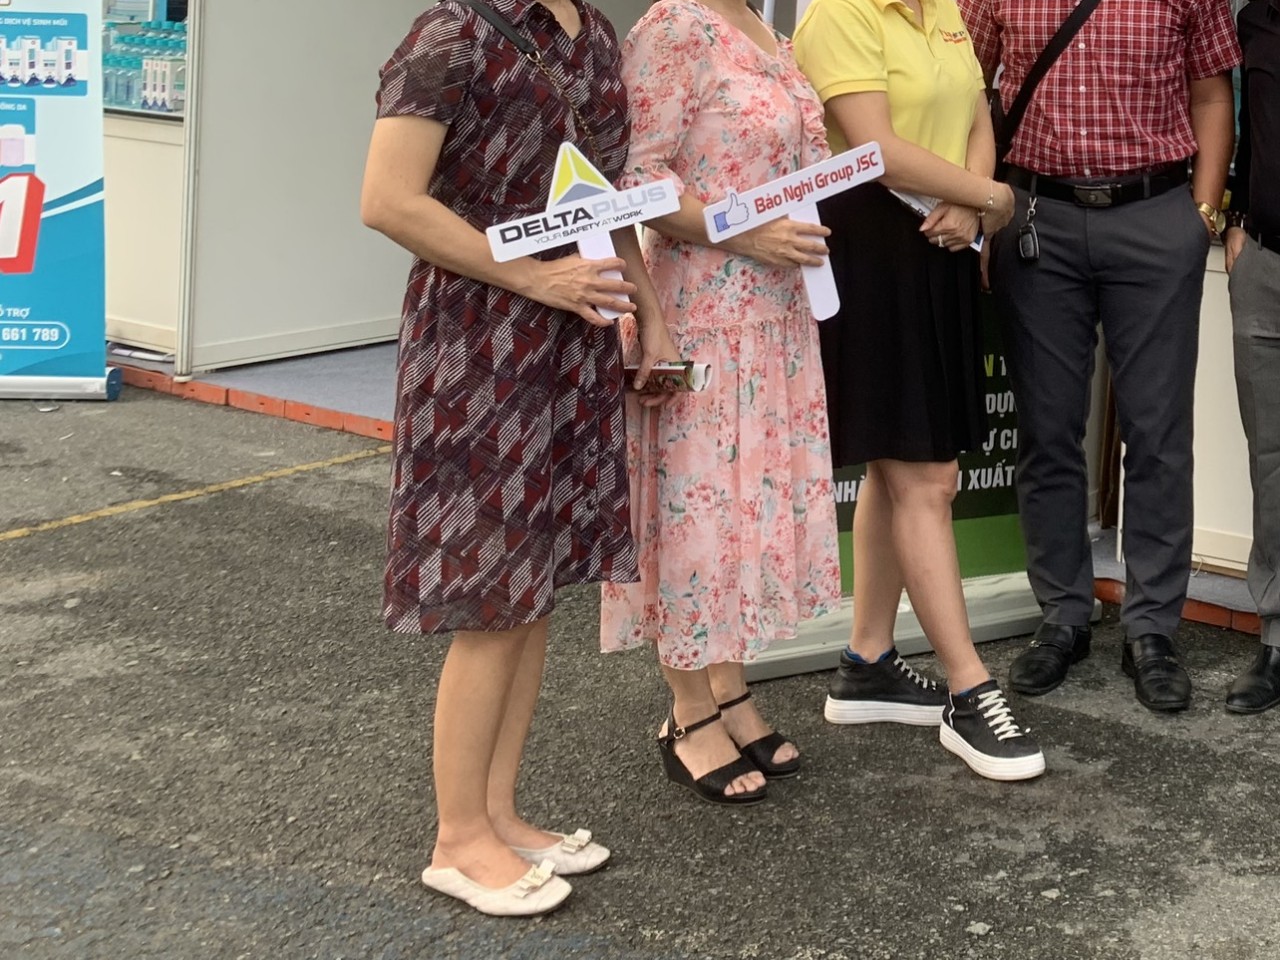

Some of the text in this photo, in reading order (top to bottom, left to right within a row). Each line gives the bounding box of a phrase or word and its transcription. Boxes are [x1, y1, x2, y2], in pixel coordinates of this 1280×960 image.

[754, 151, 879, 214] Bảo Nghi Group JSC
[498, 185, 668, 245] DELTAPLUS
[533, 209, 644, 244] YOUR SAFETY AT WORK
[2, 327, 60, 342] 661 789
[833, 459, 1016, 504] NH XUẤT
